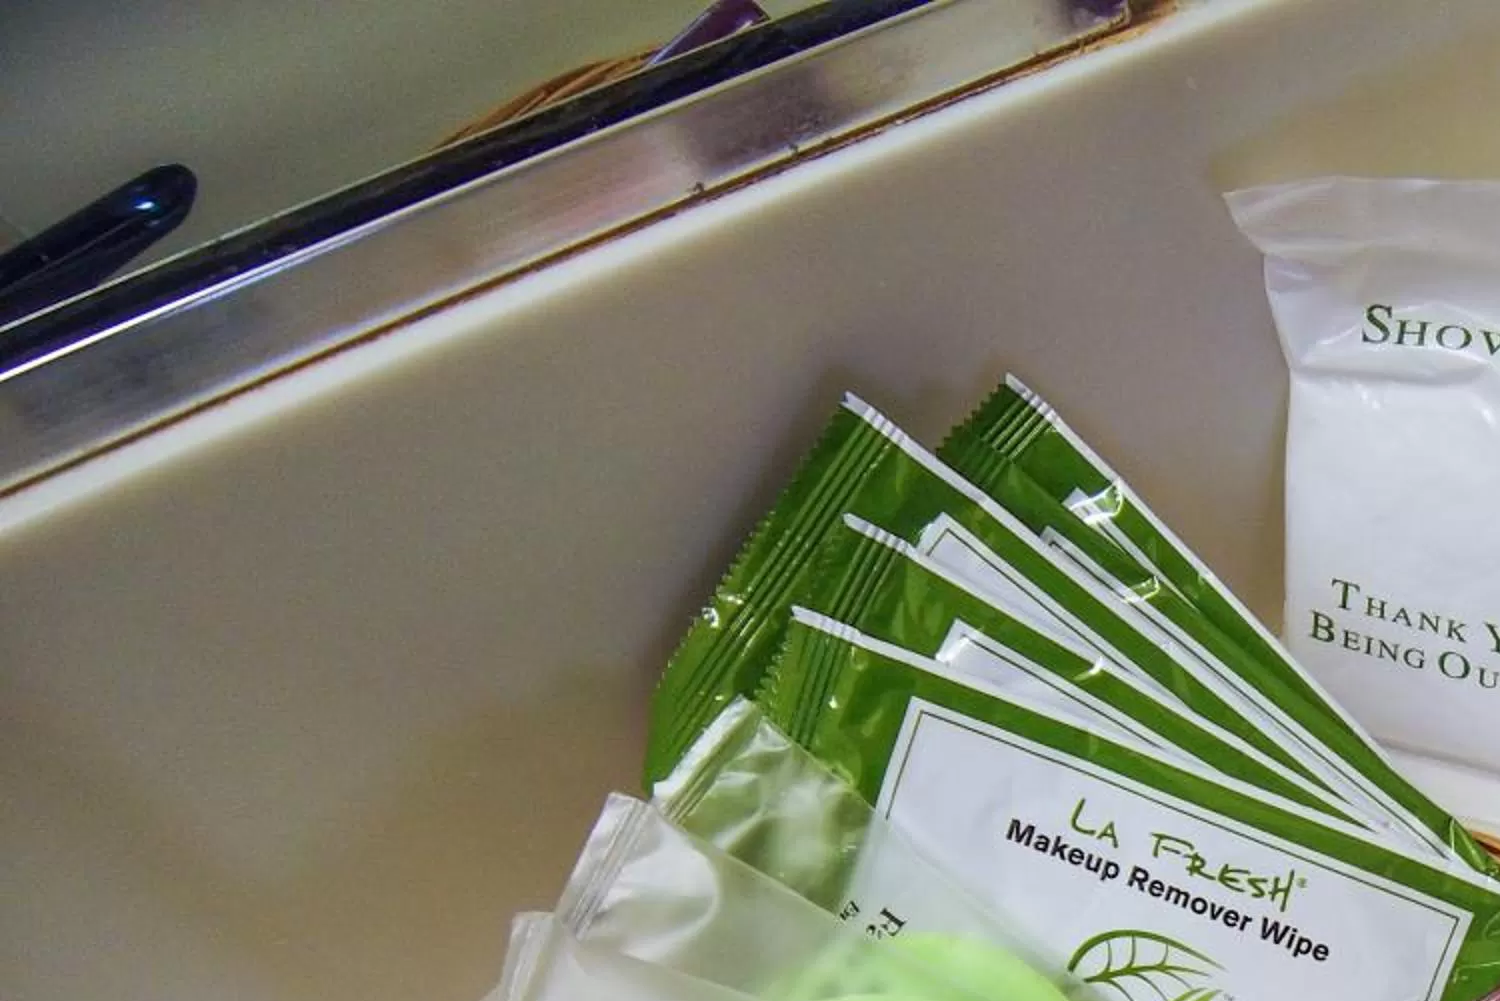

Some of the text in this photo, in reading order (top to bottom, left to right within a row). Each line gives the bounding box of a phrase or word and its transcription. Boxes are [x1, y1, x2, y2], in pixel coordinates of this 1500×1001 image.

[1310, 610, 1426, 669] BEING
[1331, 578, 1468, 643] THANK
[1070, 798, 1119, 848] LA
[1005, 818, 1330, 962] Makeup Remover Wipe
